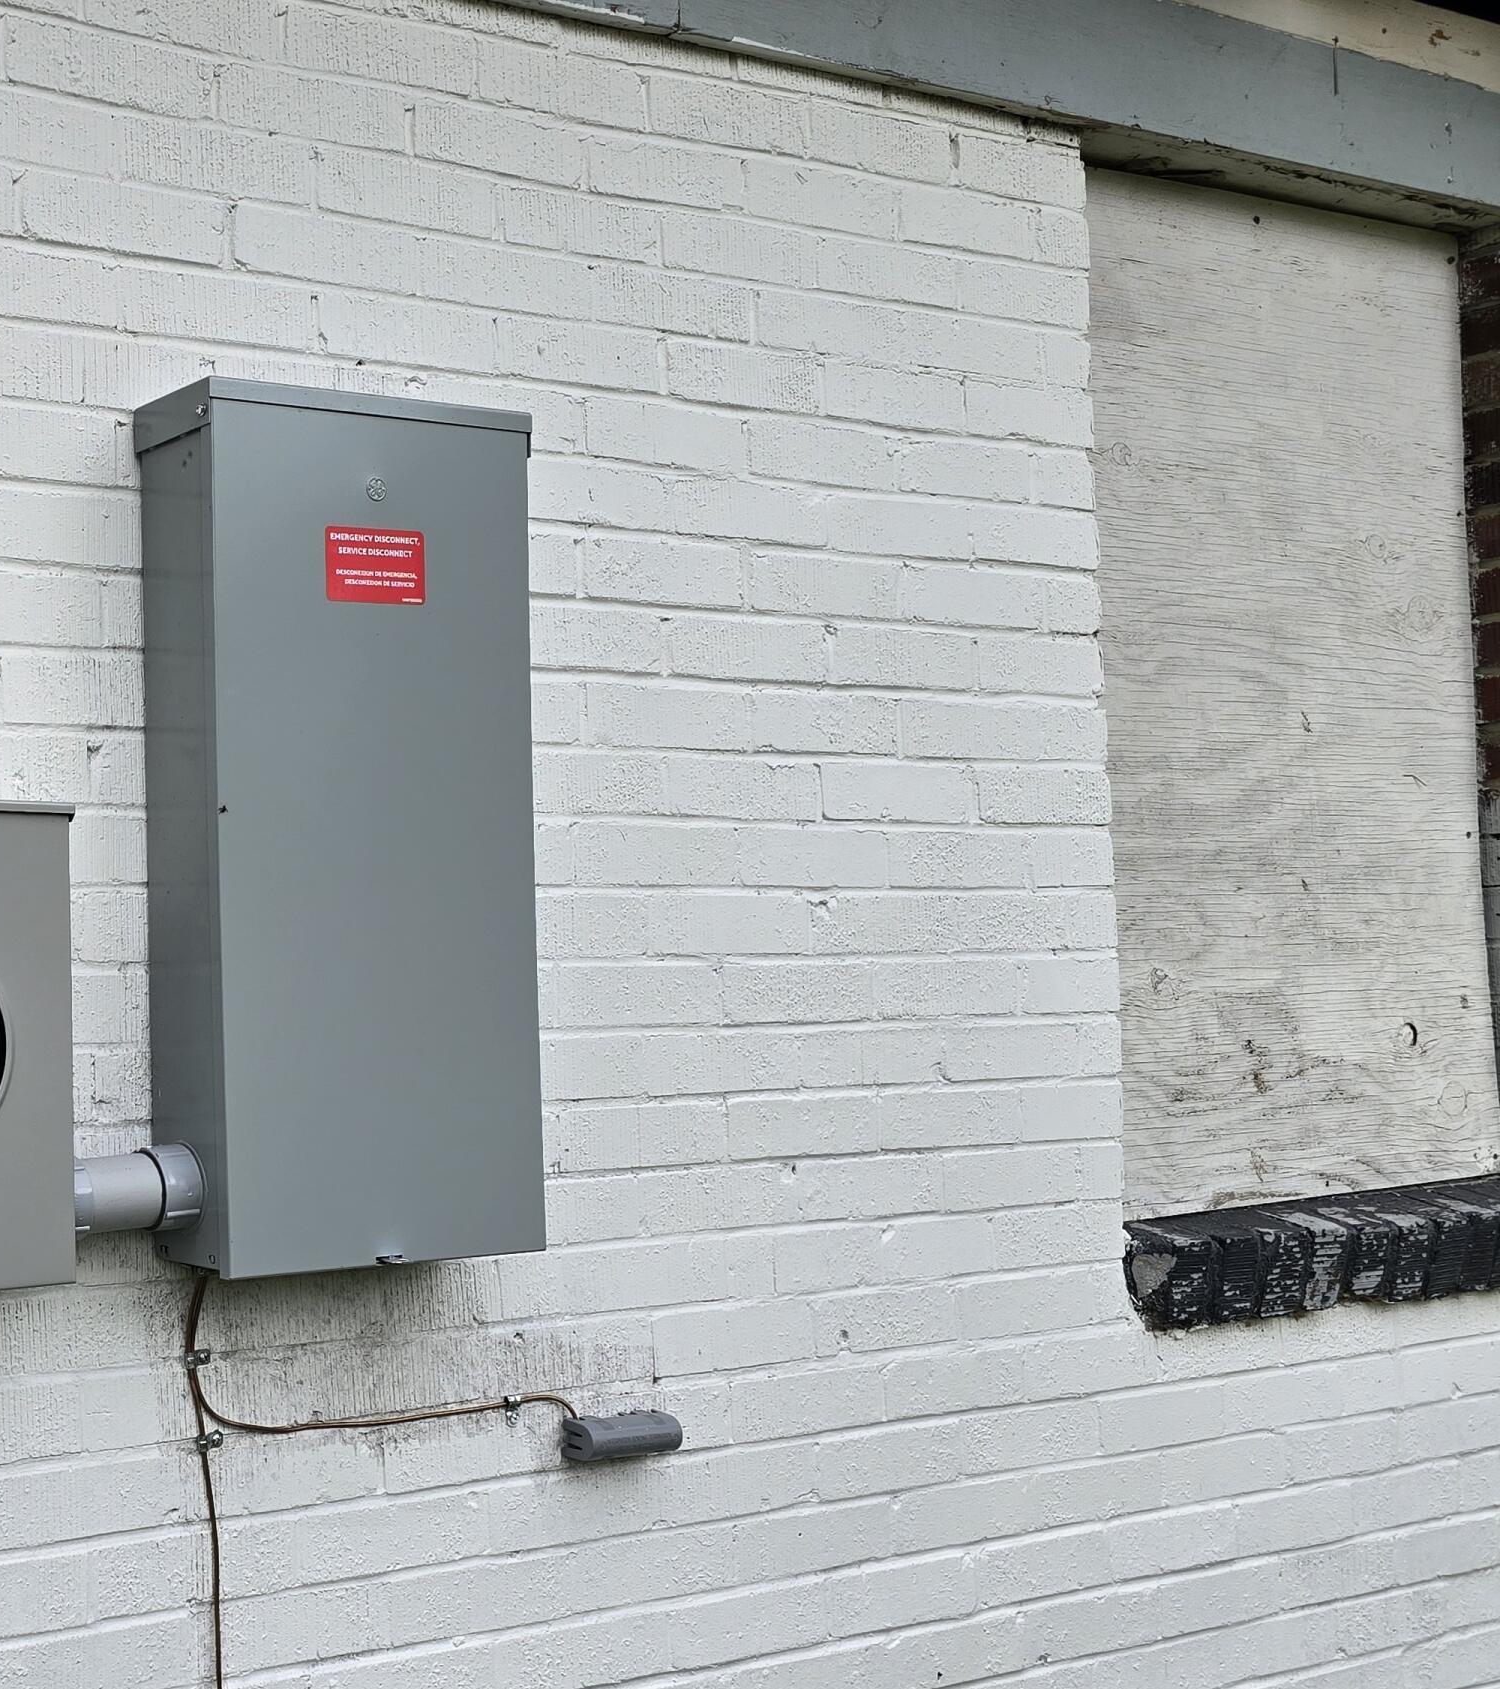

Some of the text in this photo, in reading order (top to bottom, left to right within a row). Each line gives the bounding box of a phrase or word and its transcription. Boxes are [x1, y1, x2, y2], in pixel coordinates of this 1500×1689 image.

[329, 532, 421, 547] EMERGENCY DISCONNECT,
[338, 546, 413, 558] SERVICE DISCONNECT
